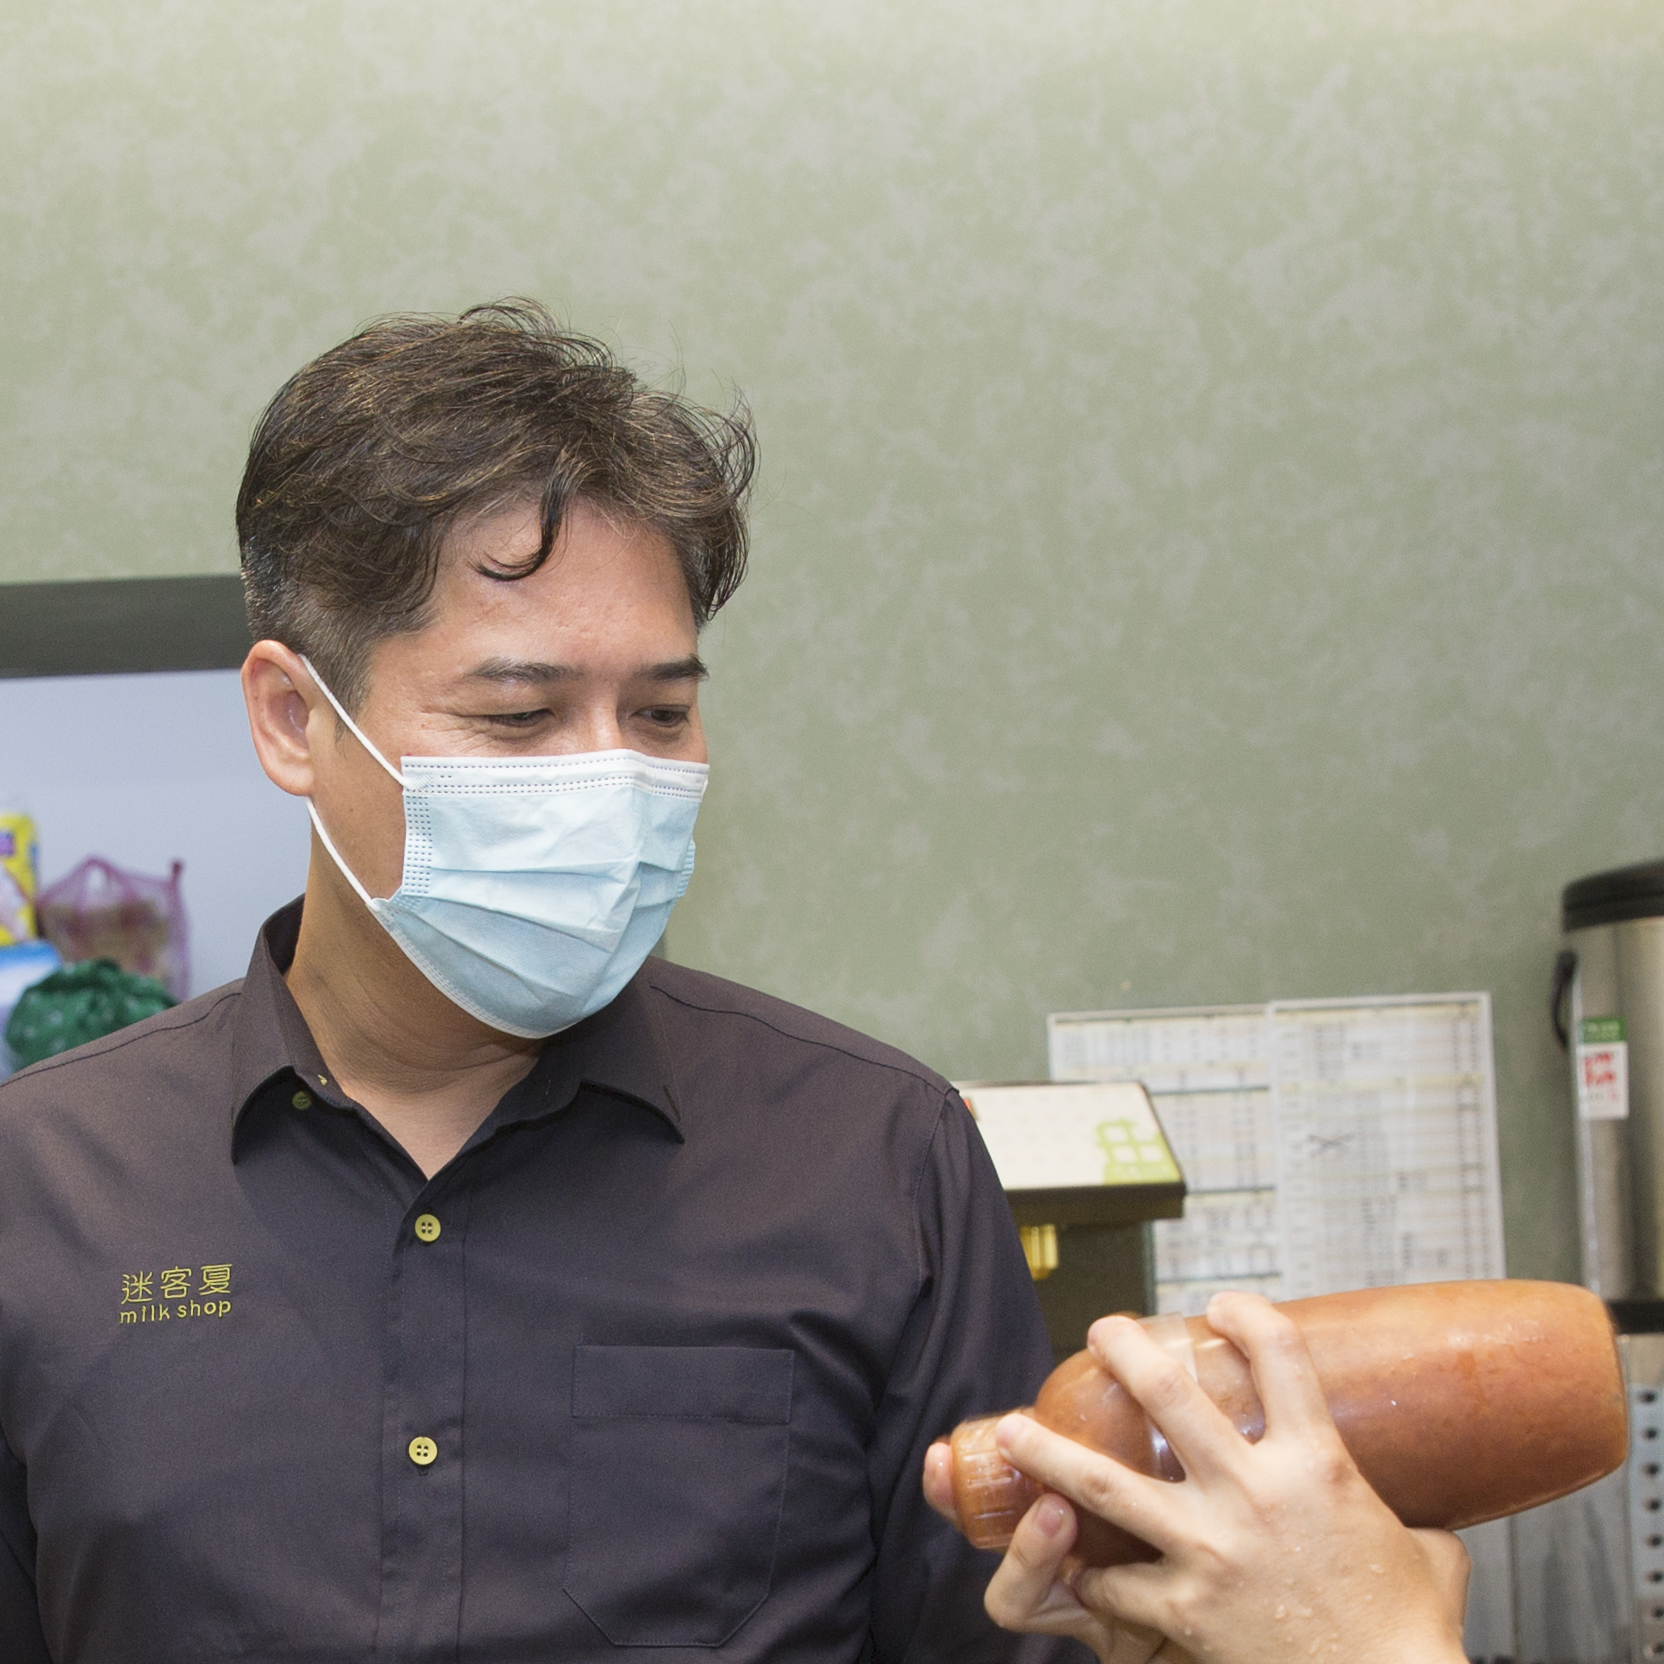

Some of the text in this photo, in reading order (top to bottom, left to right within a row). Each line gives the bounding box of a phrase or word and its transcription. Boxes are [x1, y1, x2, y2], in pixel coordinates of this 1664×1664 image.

[121, 1263, 233, 1305] 迷客夏
[119, 1299, 232, 1324] milk shop
